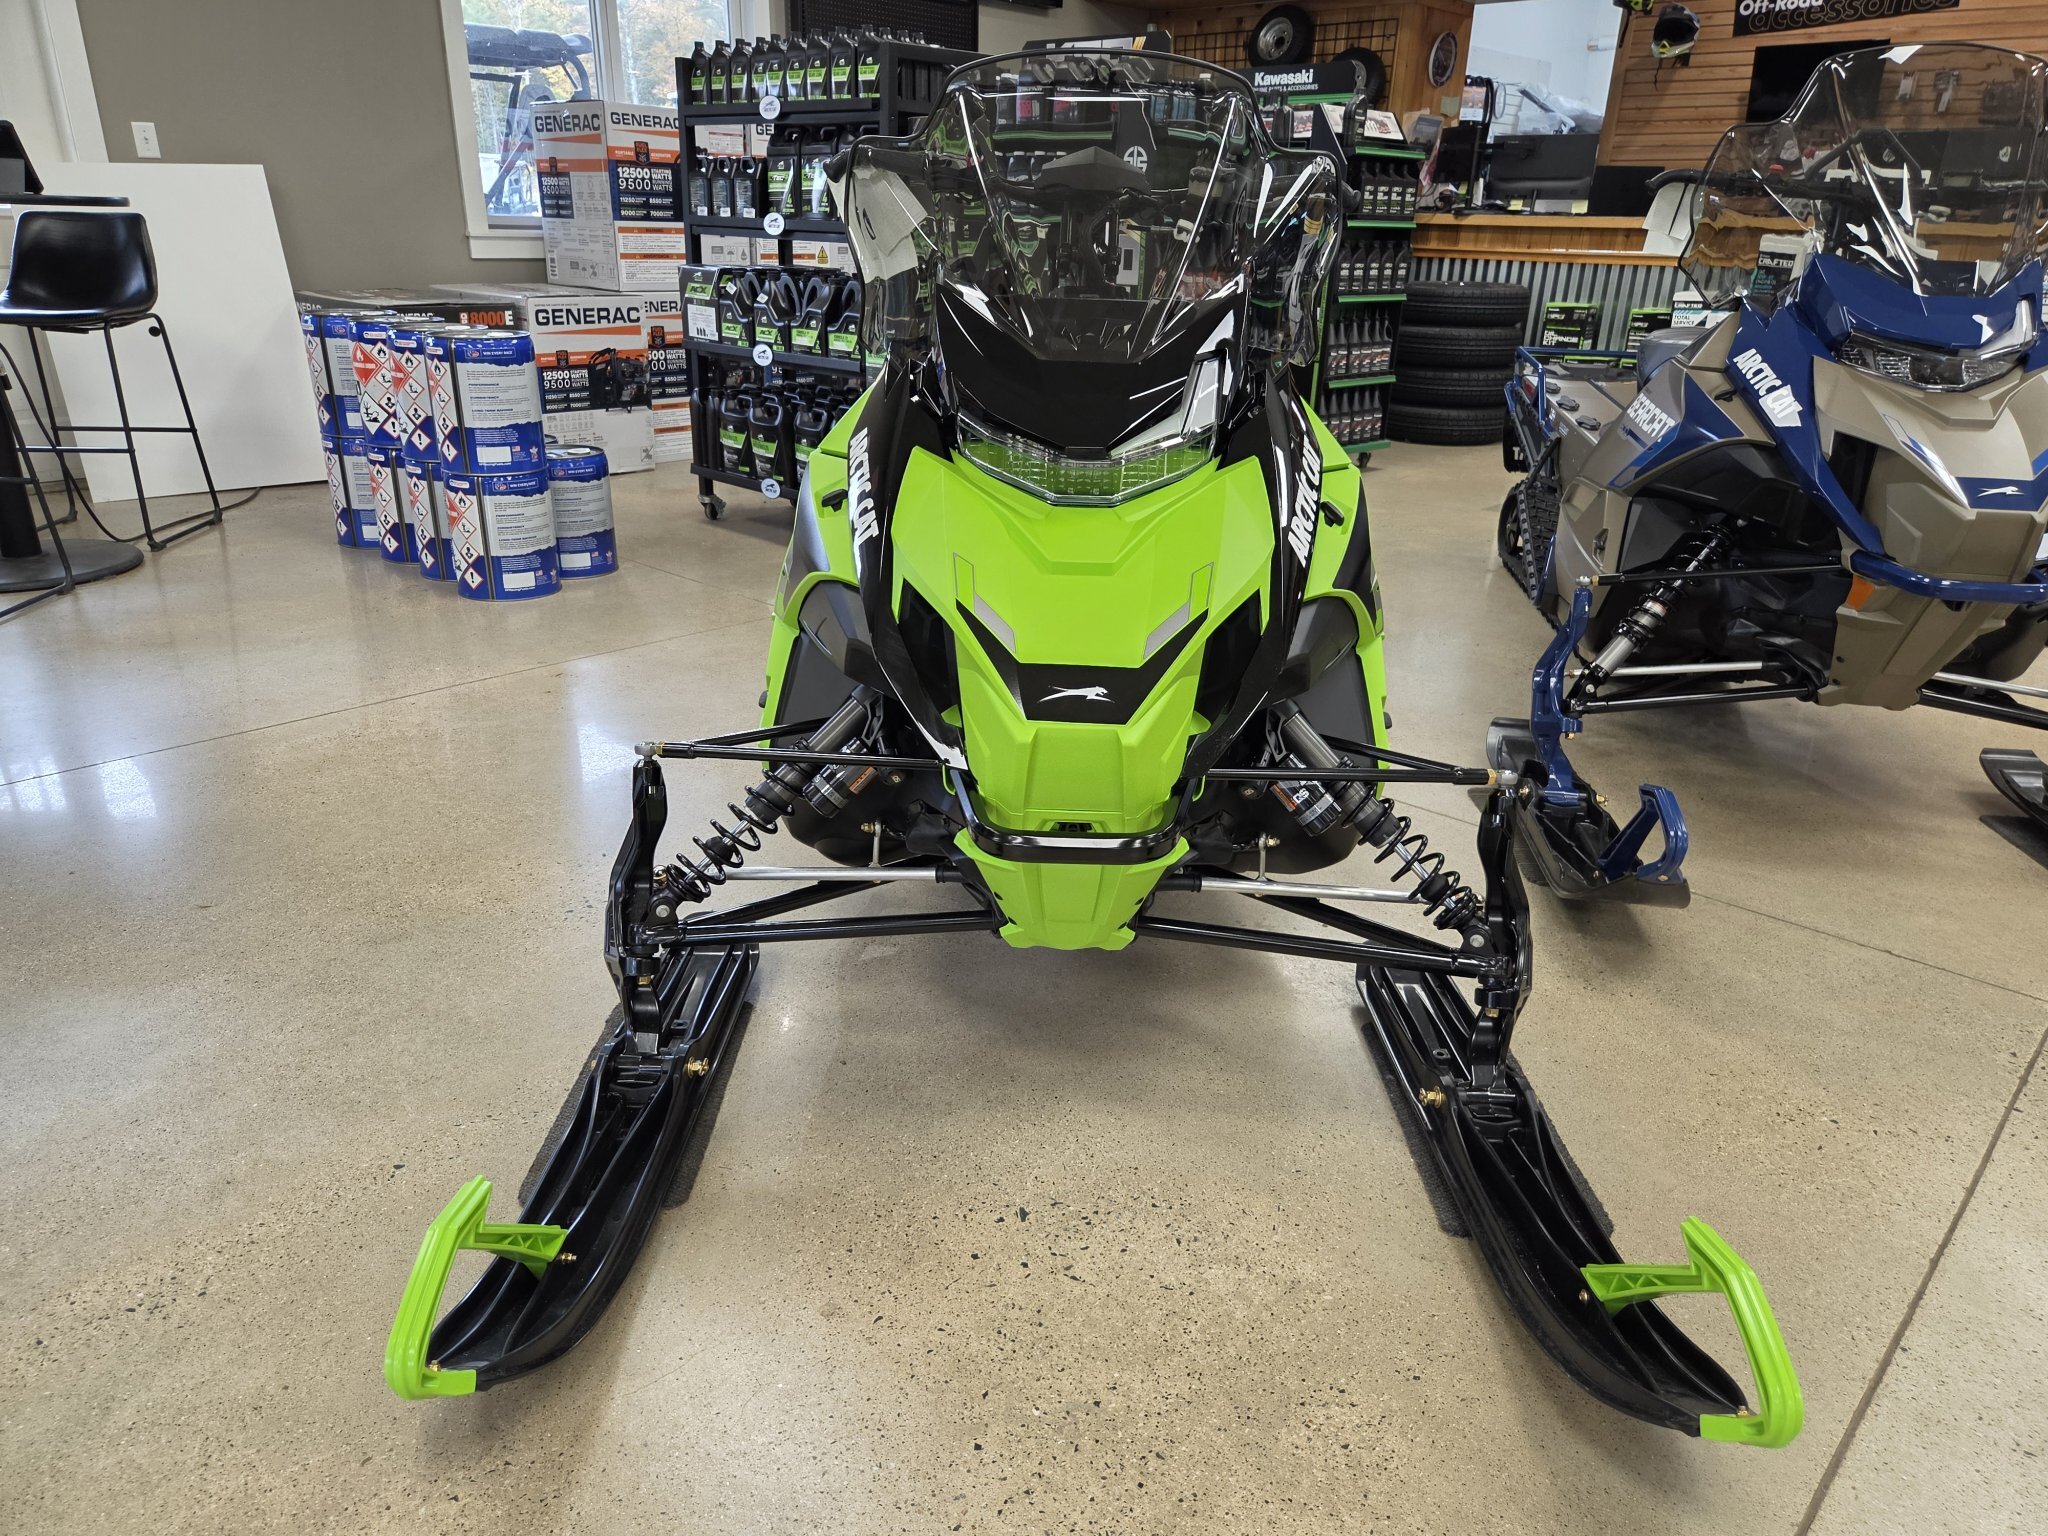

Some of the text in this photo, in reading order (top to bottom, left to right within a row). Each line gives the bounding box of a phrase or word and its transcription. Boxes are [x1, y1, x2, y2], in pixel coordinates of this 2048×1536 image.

[1254, 68, 1314, 87] Kawasaki
[534, 113, 600, 133] GENERAC
[617, 167, 651, 179] 12500
[651, 173, 673, 181] WATTS
[541, 176, 559, 186] 12500
[618, 178, 651, 190] 9500
[543, 185, 559, 194] 9500
[1758, 257, 1794, 267] CRAFTED
[689, 285, 708, 294] ACX
[470, 310, 513, 326] 8000E
[535, 306, 641, 326] GENERAC
[542, 370, 570, 380] 12500
[543, 379, 570, 389] 9500
[1732, 348, 1803, 420] ARCTIC CAT
[849, 427, 880, 546] ARCTIC CAT
[1288, 434, 1321, 568] ARCTIC CAT
